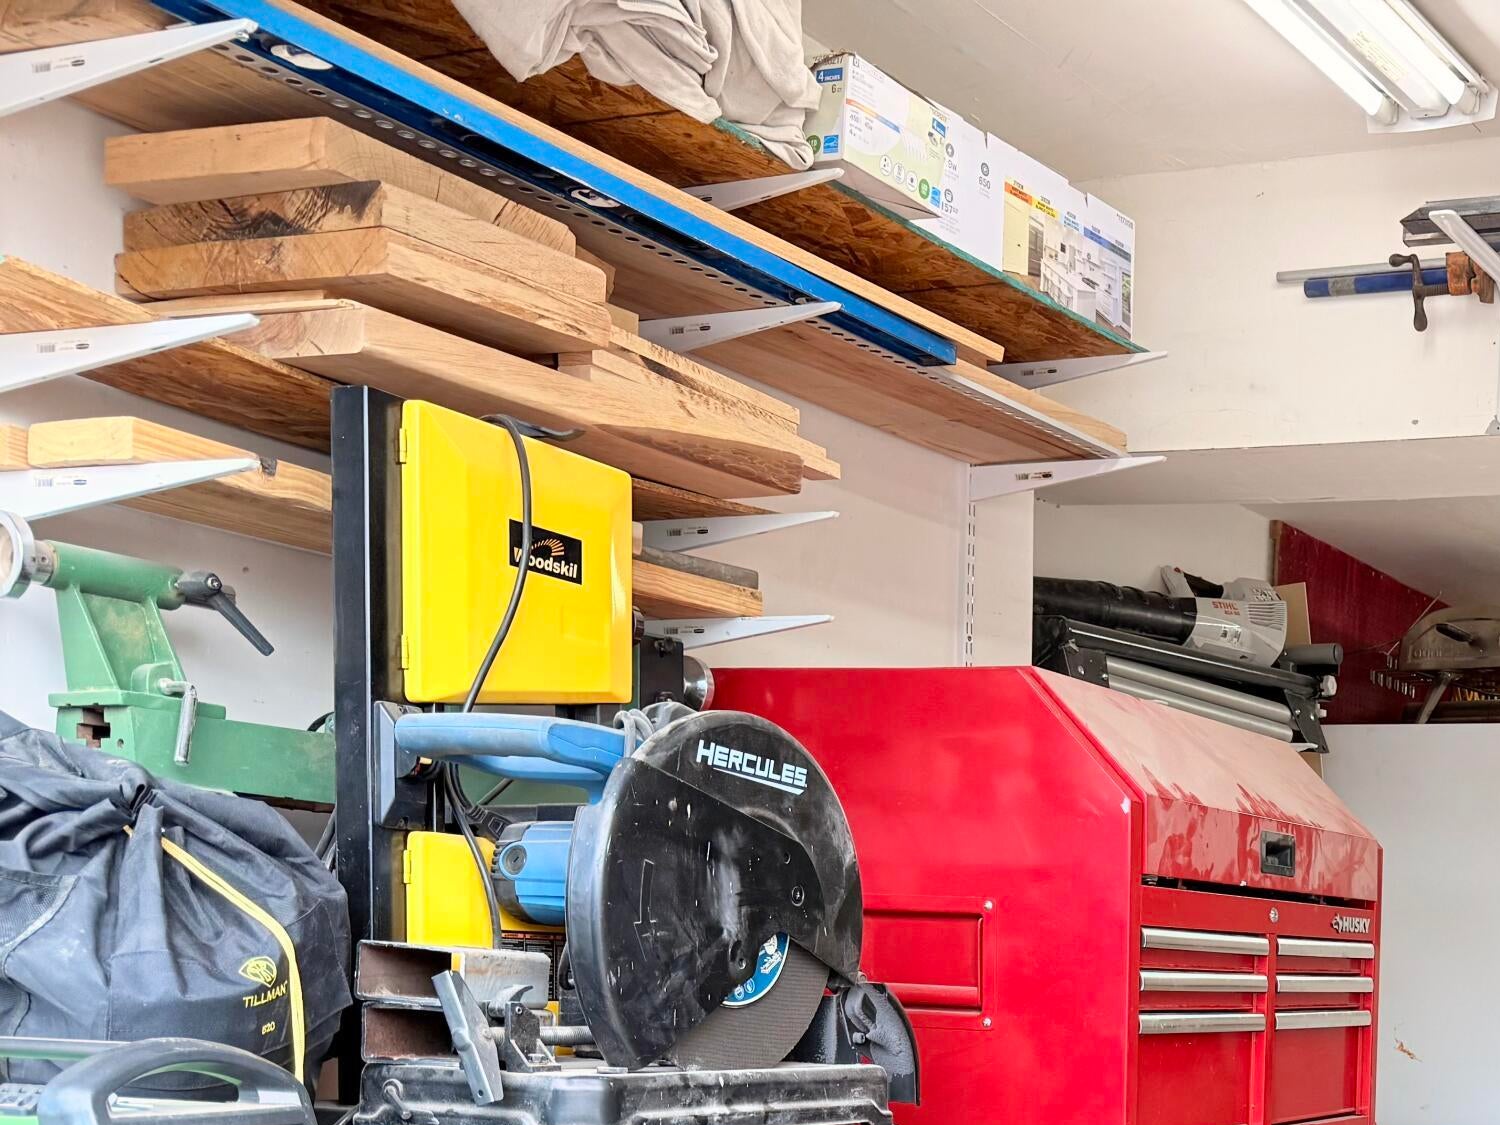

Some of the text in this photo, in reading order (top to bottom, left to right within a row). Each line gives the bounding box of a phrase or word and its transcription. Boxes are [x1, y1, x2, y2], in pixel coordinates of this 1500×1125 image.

[1211, 600, 1238, 611] STIHL
[696, 739, 808, 788] HERCULES
[1342, 916, 1370, 934] HUSKY
[242, 982, 288, 1009] TILLMAN
